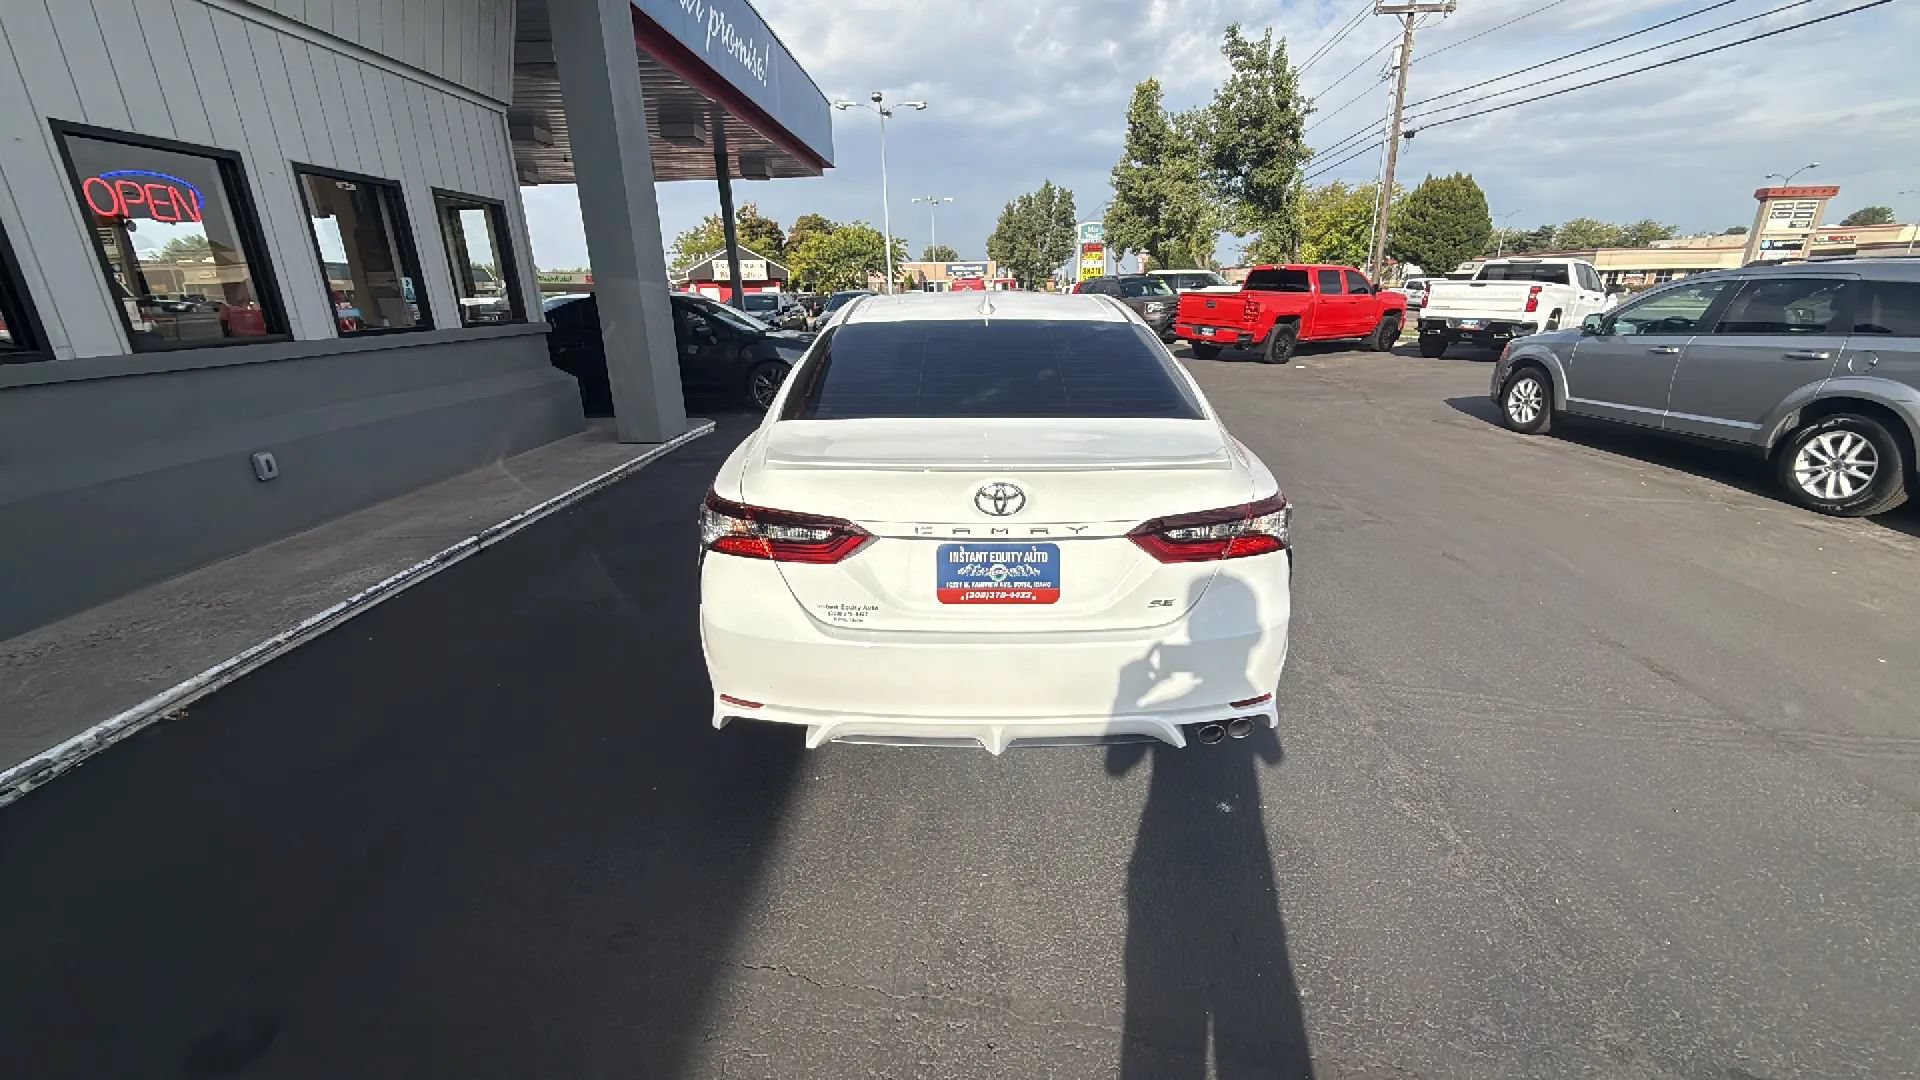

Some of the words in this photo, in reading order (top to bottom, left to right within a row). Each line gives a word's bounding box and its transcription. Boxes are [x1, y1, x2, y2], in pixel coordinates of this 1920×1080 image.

[705, 5, 770, 87] promise!
[82, 177, 202, 223] OPEN
[914, 525, 1089, 535] CAMRY
[949, 551, 989, 563] INSTANT
[989, 551, 1023, 563] EQUITY
[1023, 551, 1049, 563] AUTO
[1147, 598, 1177, 608] SE
